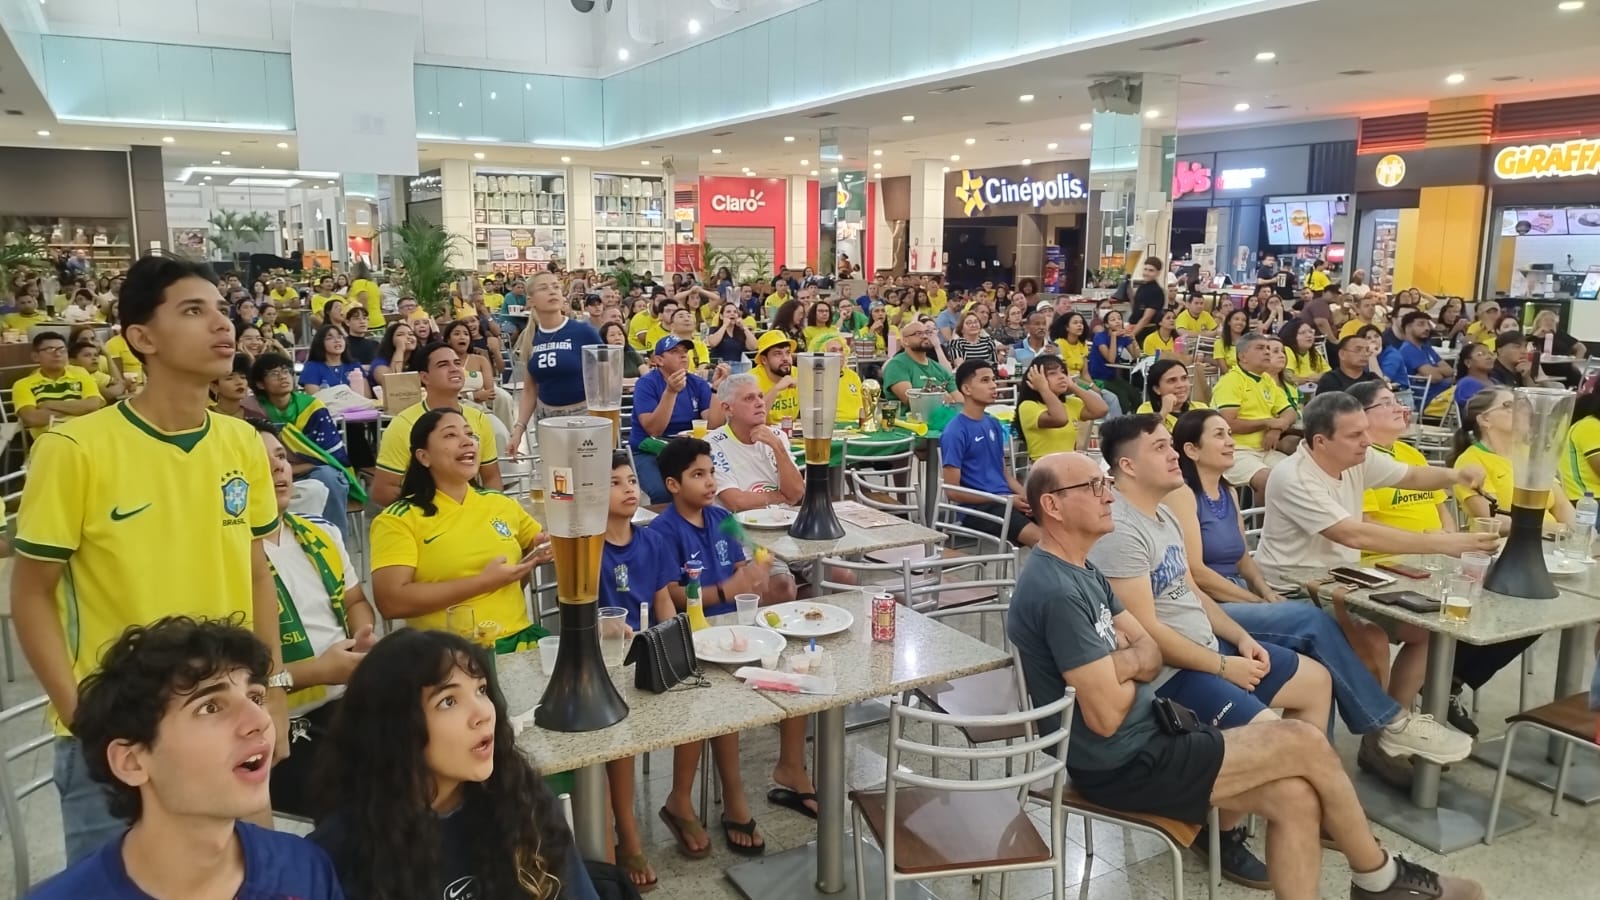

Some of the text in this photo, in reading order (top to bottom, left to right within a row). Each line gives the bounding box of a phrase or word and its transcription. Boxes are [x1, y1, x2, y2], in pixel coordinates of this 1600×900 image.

[711, 193, 759, 212] Claro
[533, 341, 573, 352] RASILEIRAGEM
[538, 352, 557, 368] 26
[222, 517, 246, 526] BRASIL
[280, 631, 306, 646] SIL
